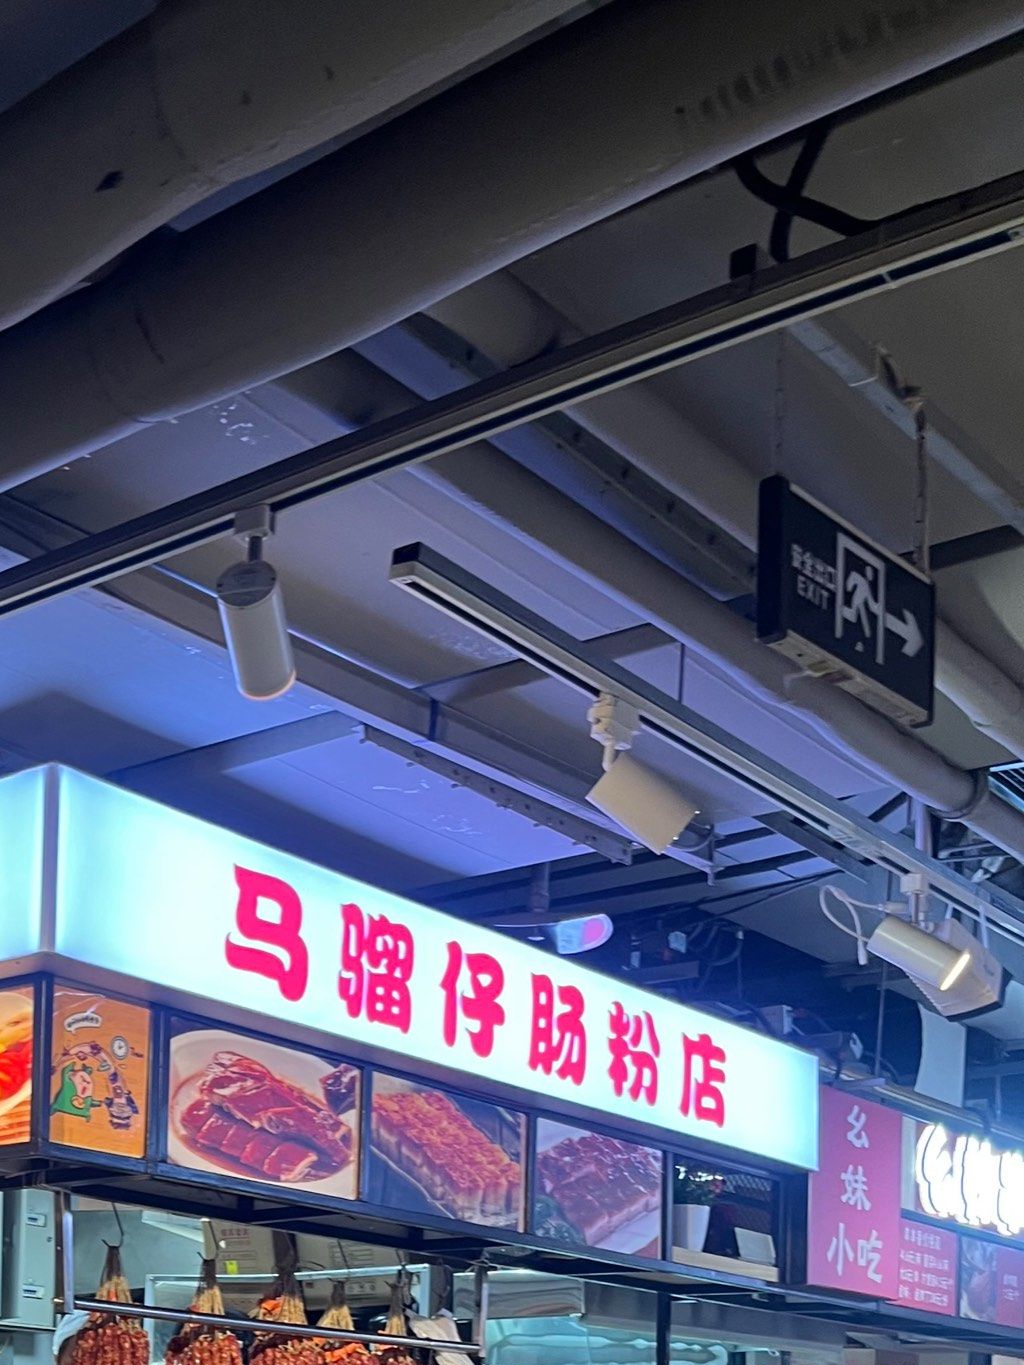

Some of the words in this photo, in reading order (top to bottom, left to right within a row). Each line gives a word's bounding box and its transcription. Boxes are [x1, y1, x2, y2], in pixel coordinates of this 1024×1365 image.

[797, 575, 829, 610] EXIT
[225, 864, 727, 1127] 马骝仔肠粉店
[827, 1222, 884, 1284] 小吃
